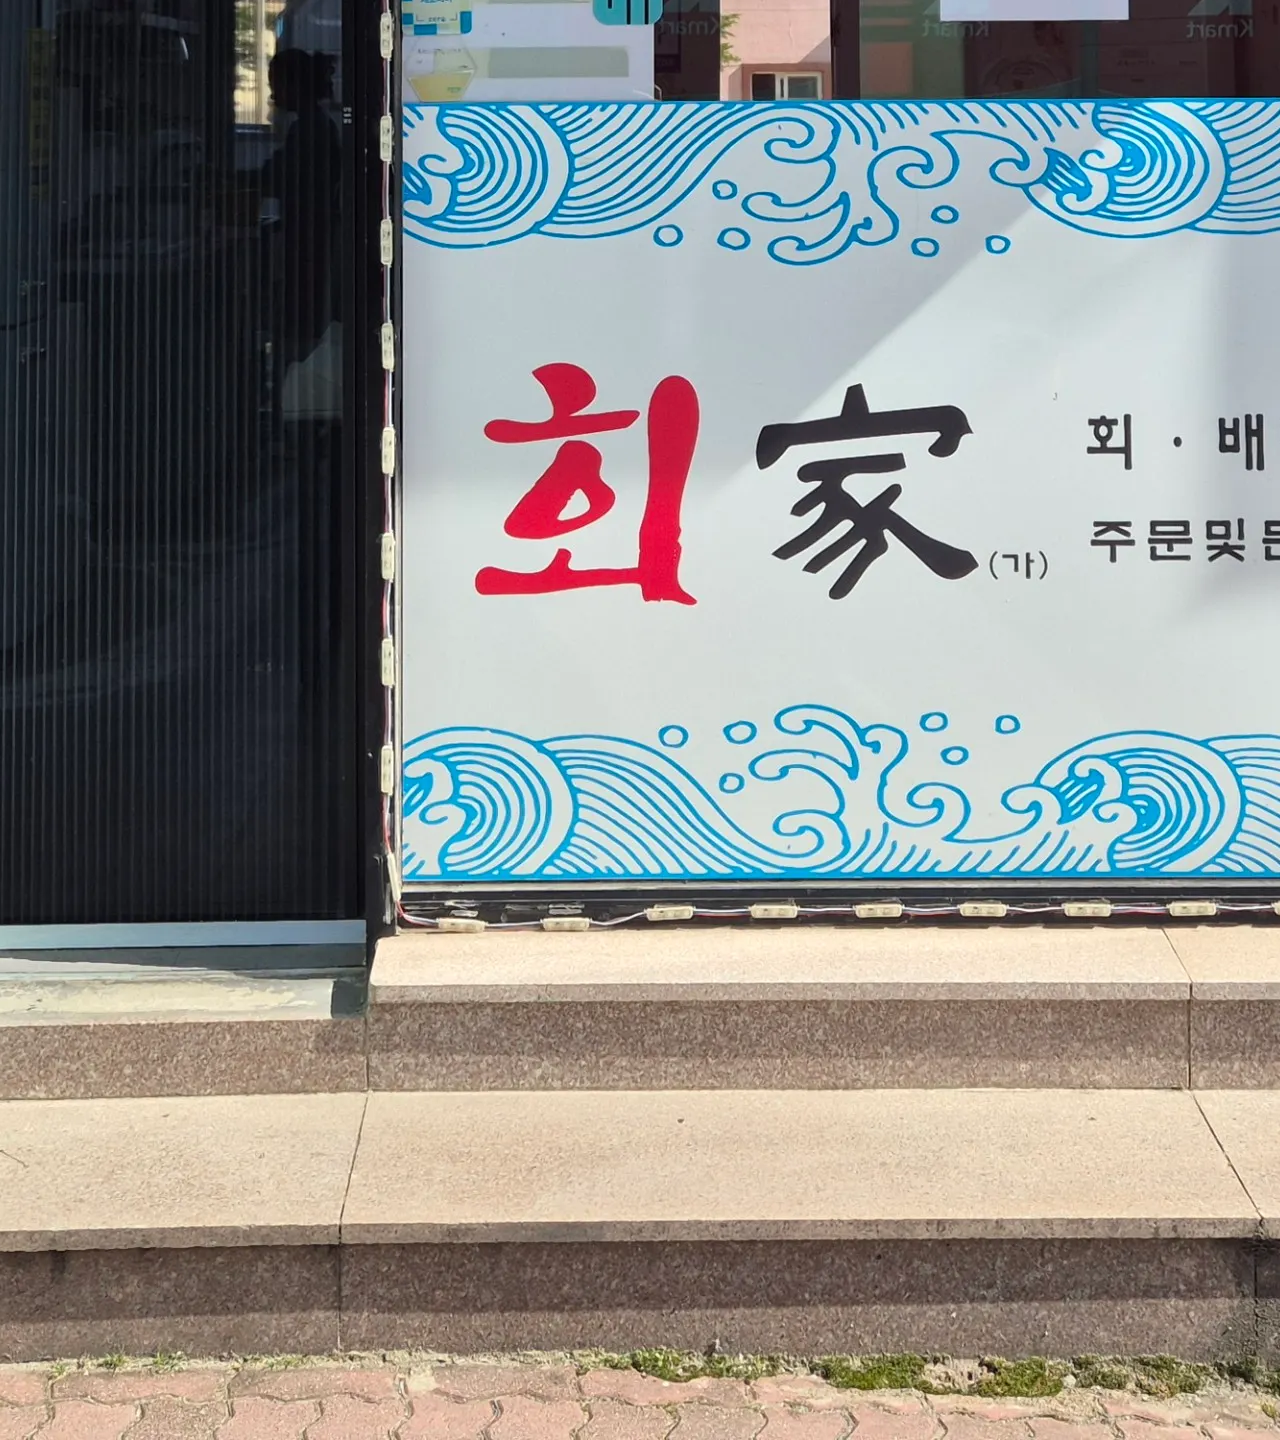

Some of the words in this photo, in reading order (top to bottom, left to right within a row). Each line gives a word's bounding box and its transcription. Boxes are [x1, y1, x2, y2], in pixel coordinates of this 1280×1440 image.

[474, 363, 700, 606] 회
[755, 383, 978, 600] 家
[1087, 414, 1133, 470] 회
